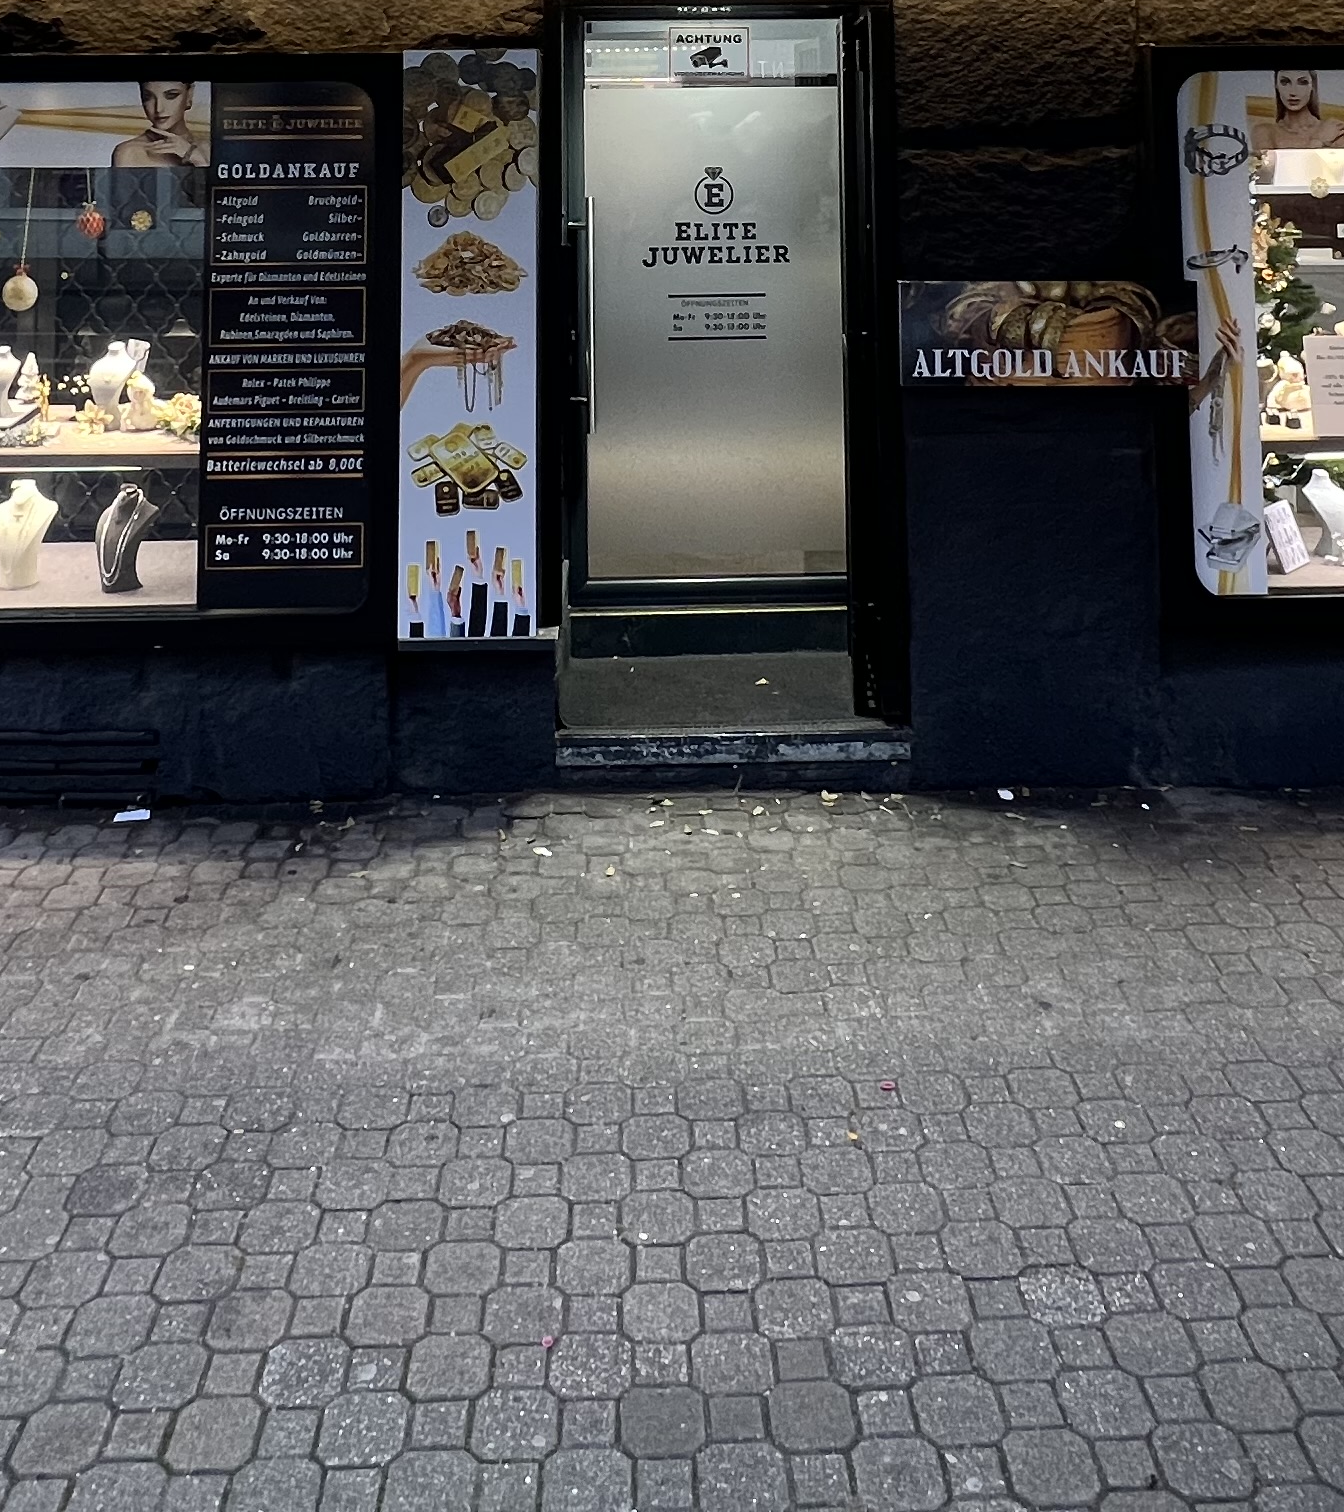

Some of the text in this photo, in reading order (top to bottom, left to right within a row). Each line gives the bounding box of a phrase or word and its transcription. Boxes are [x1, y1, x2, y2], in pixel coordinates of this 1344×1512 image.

[676, 34, 743, 44] ACHTUNG
[217, 162, 360, 179] GOLDANKAUF
[674, 221, 757, 241] ELITE
[641, 245, 791, 268] JUWELIER
[211, 271, 367, 284] Experte für Diamanten und Edelsteinen
[299, 329, 316, 339] und
[209, 354, 242, 365] ANKAUF
[242, 354, 259, 364] VON
[260, 353, 294, 364] MARKEN
[295, 353, 312, 364] UND
[912, 348, 1190, 380] ALTGOLD ANKAUF
[242, 377, 265, 388] Rolex
[273, 377, 297, 387] Patek
[207, 417, 364, 428] ANFERTIGUNGEN UND REPARATUREN
[207, 432, 365, 445] von Goldschmuck und Silberschmuck
[206, 457, 364, 472] Batteriewechsel ab 8,00€
[219, 506, 344, 520] ÖFFNUNGSZEITEN
[215, 534, 250, 545] Mo-Fr
[333, 532, 354, 544] Uhr
[214, 549, 230, 561] Sa
[332, 548, 354, 559] Uhr
